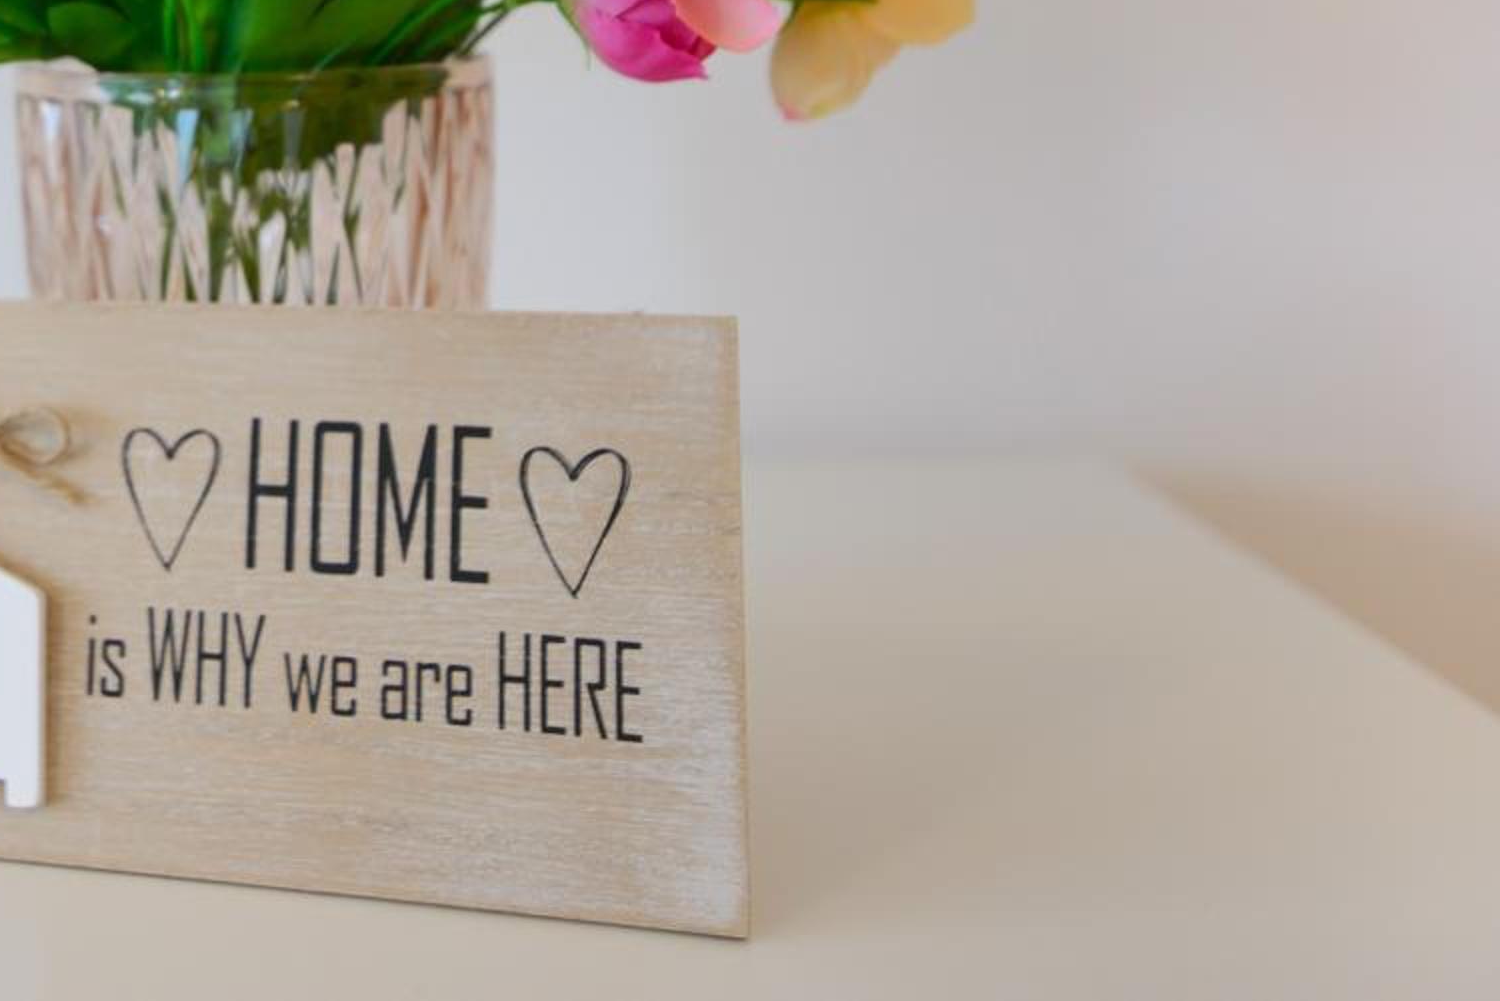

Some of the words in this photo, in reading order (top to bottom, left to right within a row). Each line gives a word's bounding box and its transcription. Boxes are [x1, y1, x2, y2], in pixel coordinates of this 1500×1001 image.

[245, 416, 493, 585] HOME
[85, 614, 127, 699] is
[146, 606, 267, 709] WHY
[283, 651, 358, 718] we
[380, 659, 474, 728] are
[497, 630, 644, 744] HERE
